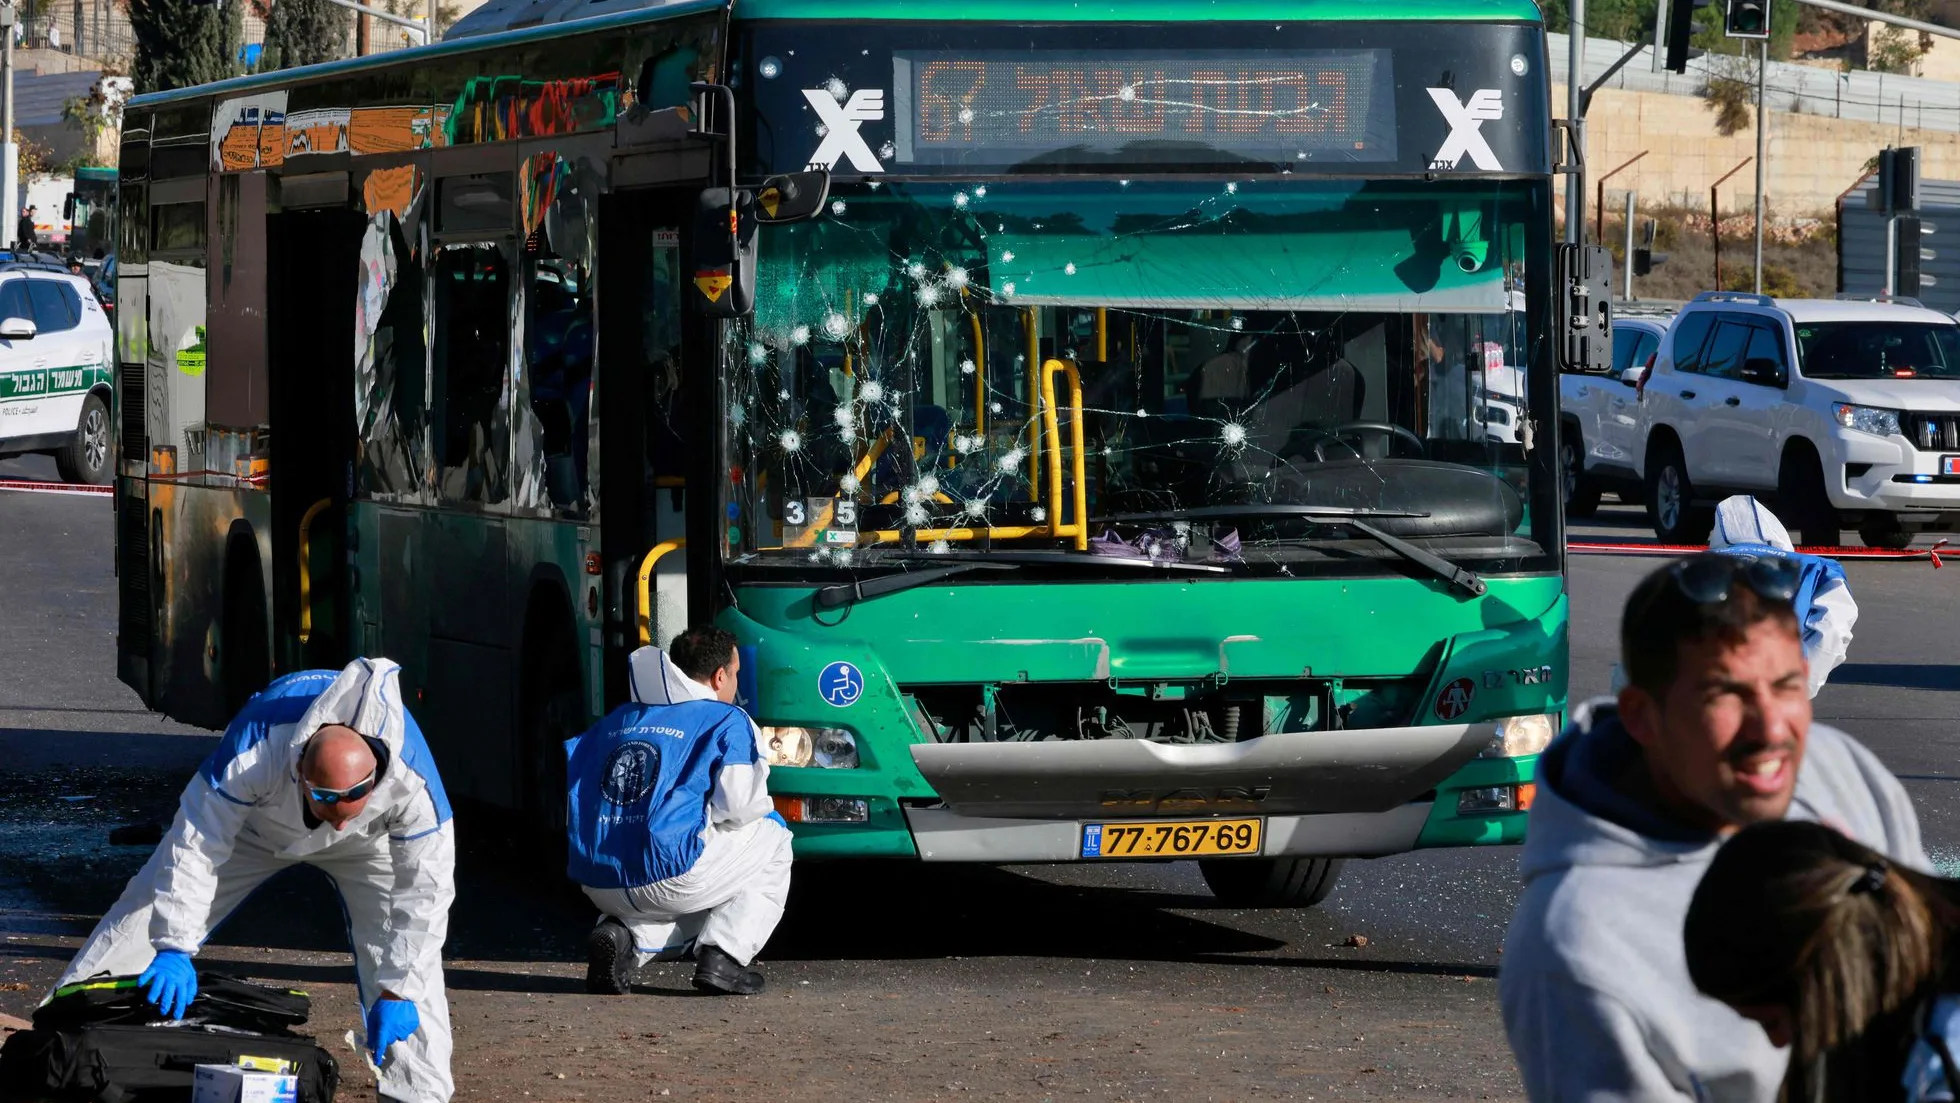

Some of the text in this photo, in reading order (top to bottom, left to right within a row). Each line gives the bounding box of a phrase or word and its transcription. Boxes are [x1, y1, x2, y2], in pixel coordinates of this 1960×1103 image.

[921, 61, 985, 141] 67
[1017, 65, 1164, 133] שאול
[1433, 160, 1453, 170] אגד
[11, 369, 83, 393] משמר הגבול
[2, 406, 20, 416] POLICE
[786, 501, 805, 524] 3
[837, 501, 856, 524] 5
[638, 726, 685, 739] משטרת
[1087, 835, 1098, 848] IL
